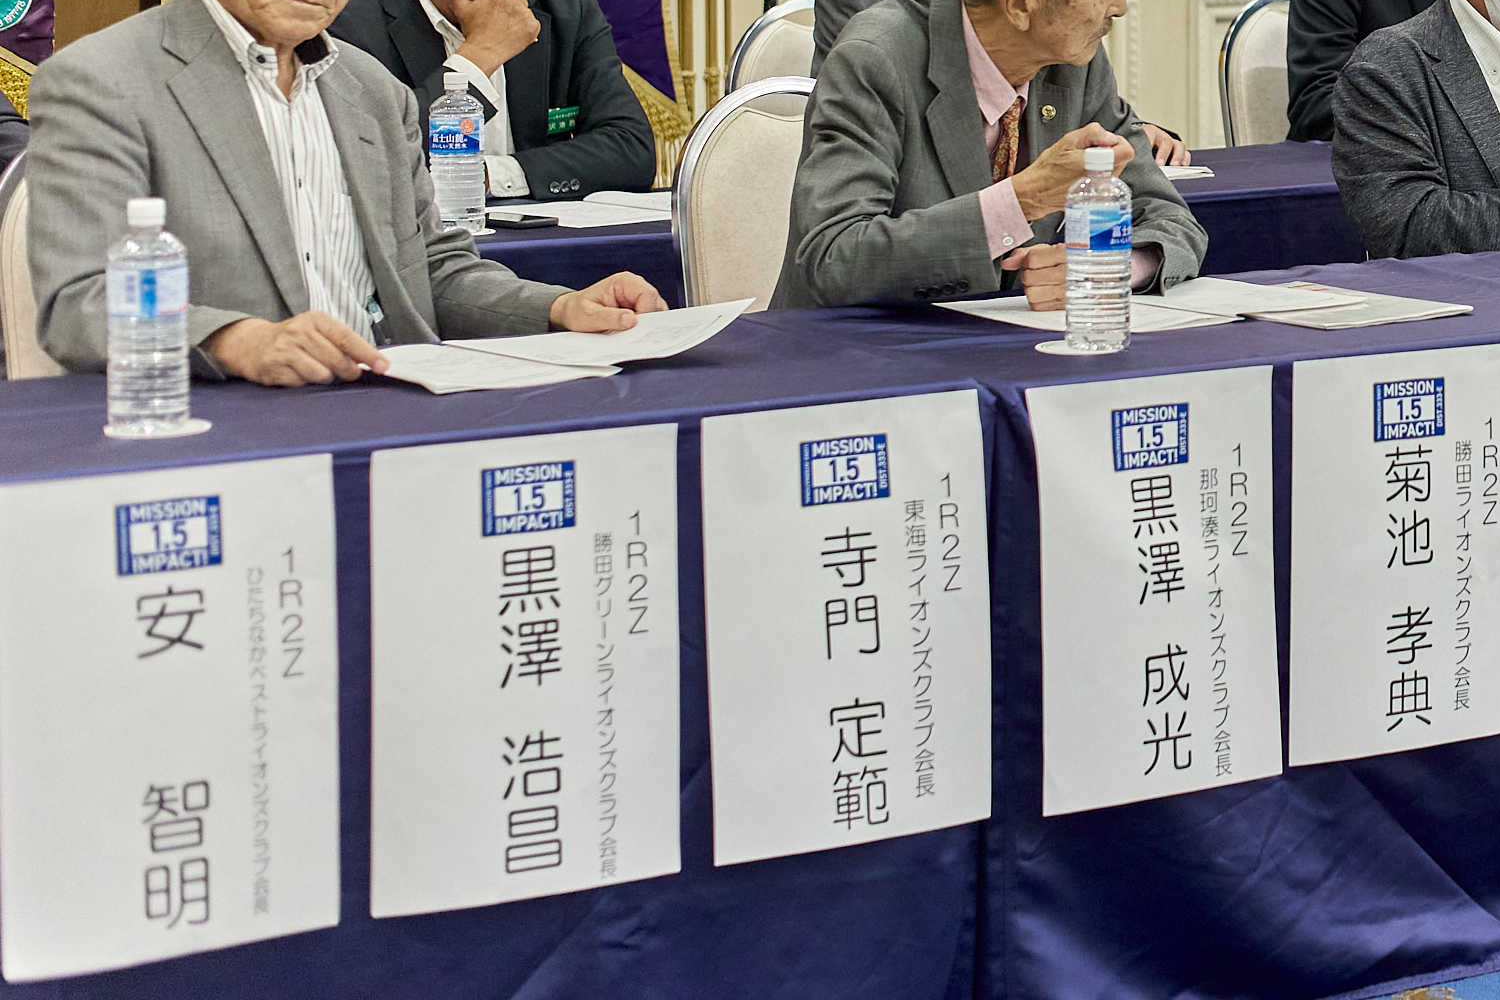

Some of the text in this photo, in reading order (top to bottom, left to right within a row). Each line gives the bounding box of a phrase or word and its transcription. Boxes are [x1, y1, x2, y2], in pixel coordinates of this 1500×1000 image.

[1383, 380, 1435, 398] MISSION
[1397, 398, 1421, 420] 1.5
[1122, 405, 1178, 425] MISSION
[1137, 425, 1164, 448] 1.5
[1179, 411, 1187, 455] DIST.333-E
[1384, 421, 1435, 440] IMPACT!
[812, 436, 875, 458] MISSION
[877, 443, 888, 489] DIST.333-E
[1124, 448, 1178, 469] IMPACT!
[494, 463, 563, 486] MISSION
[829, 457, 859, 483] 1.5
[1483, 418, 1499, 526] 1R2Z
[130, 498, 206, 522] MISSION
[514, 485, 545, 512] 1.5
[813, 482, 878, 504] IMPACT!
[1230, 442, 1249, 557] 1R2Z
[153, 519, 188, 551] 1.5
[495, 511, 563, 534] IMPACT!
[939, 473, 962, 592] 1R2Z
[131, 550, 209, 575] IMPACT!
[625, 509, 650, 635] 1R2Z
[1453, 440, 1473, 711] 勝田ライオンズクラブ会長
[1385, 444, 1433, 733] 菊池 孝典
[278, 545, 304, 678] 1R2Z
[1130, 474, 1192, 777] 黒澤 成光
[1199, 468, 1232, 778] 那珂湊ライオンズクラブ会長
[904, 499, 936, 799] 東海ライオンズクラブ会長
[820, 526, 889, 830] 寺門 定範
[498, 545, 563, 875] 黒澤 浩昌
[593, 532, 618, 879] 勝田グリーンライオンズクラブ会長
[137, 584, 210, 929] 安 智明
